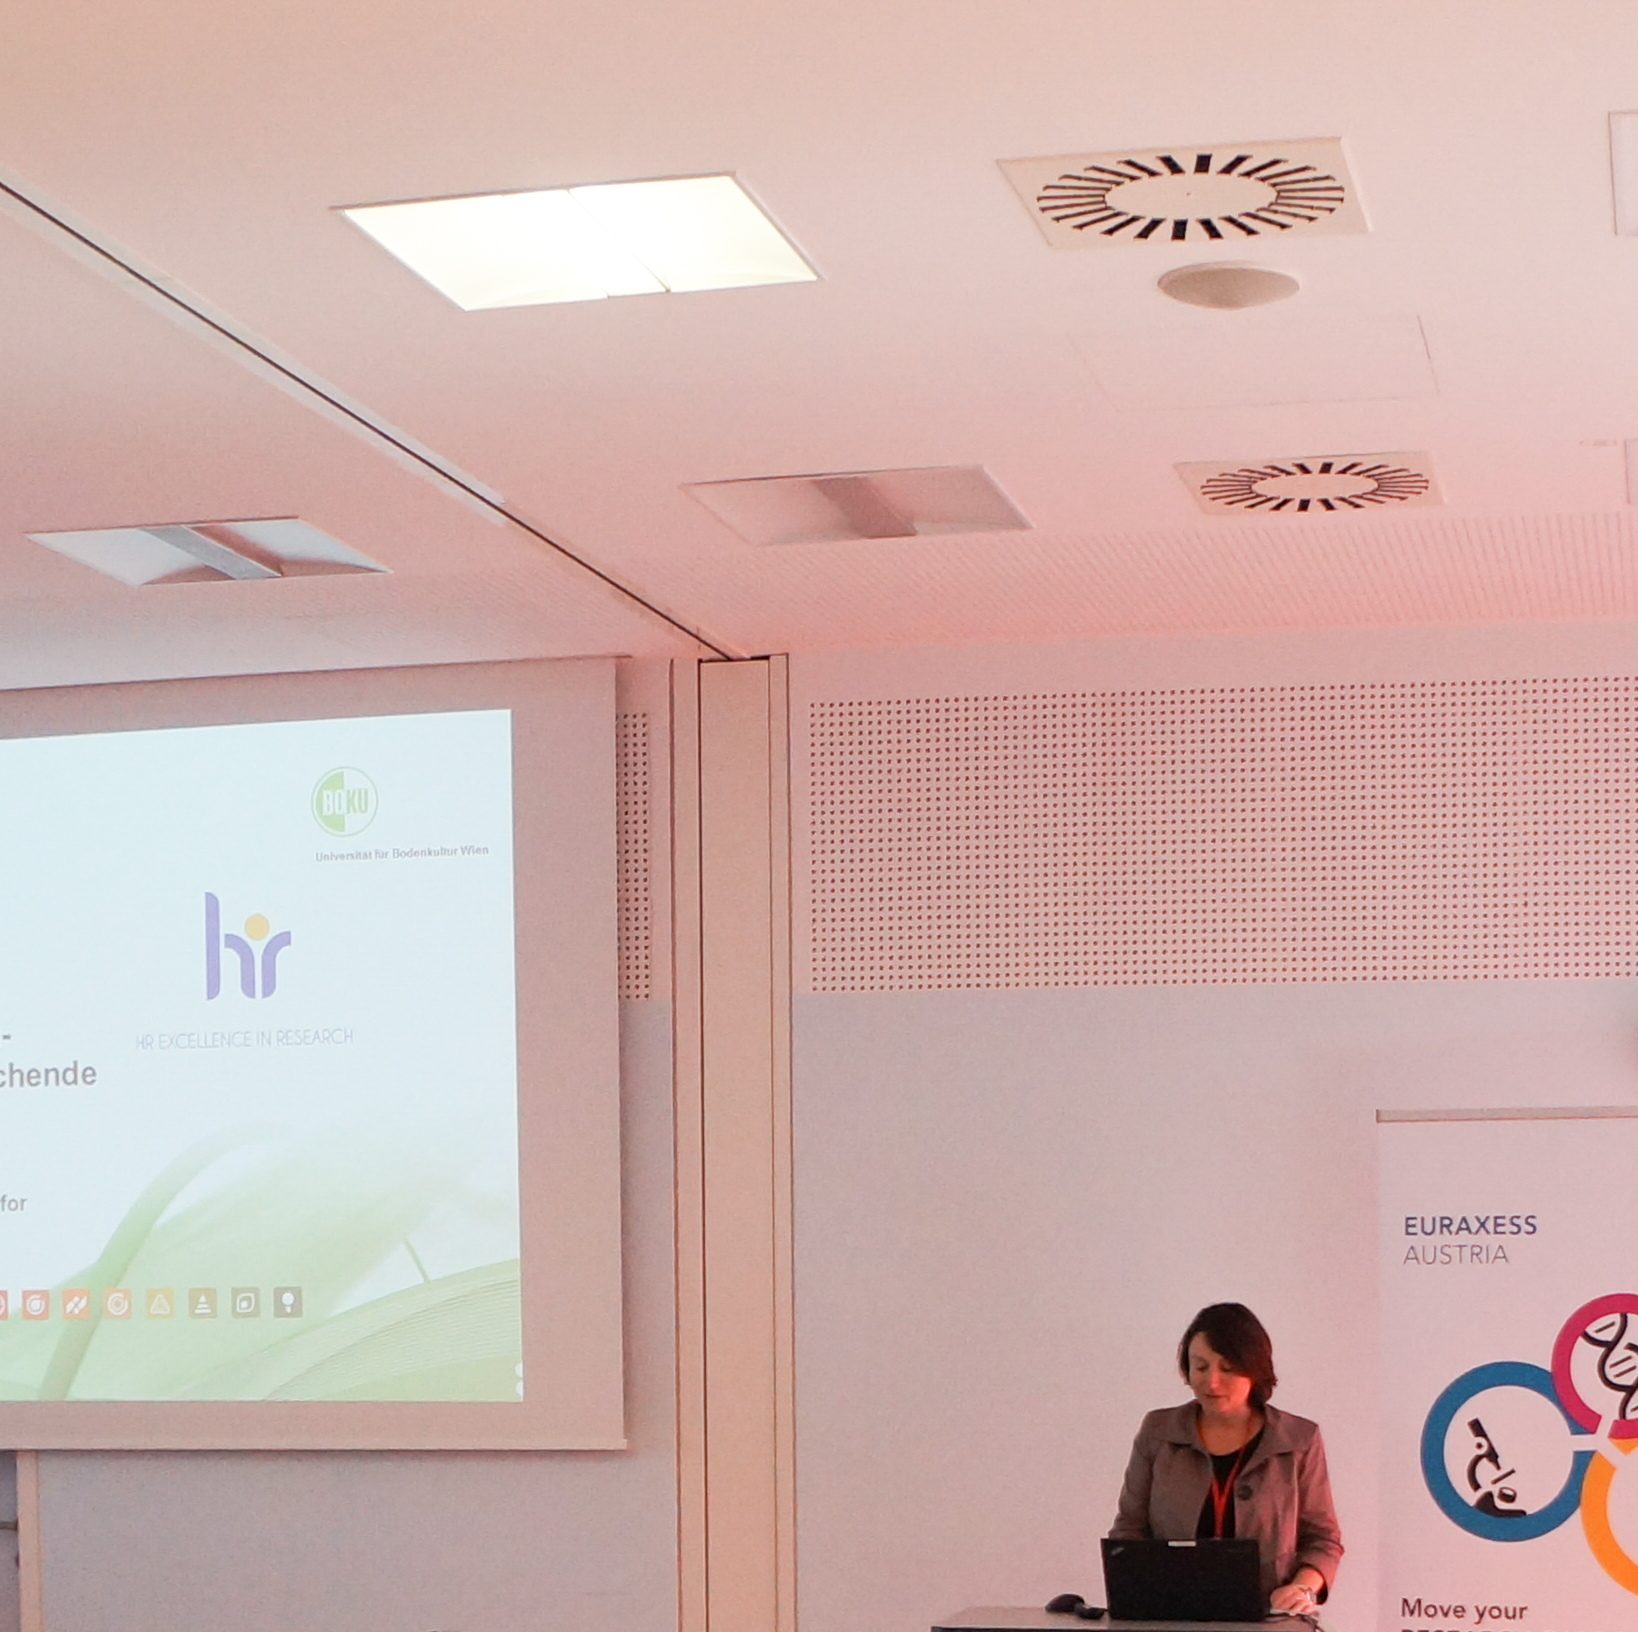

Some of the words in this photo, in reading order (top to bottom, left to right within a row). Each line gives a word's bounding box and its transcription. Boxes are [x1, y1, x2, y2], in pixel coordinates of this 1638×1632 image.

[321, 787, 369, 816] BOKU
[460, 845, 490, 856] Wien
[136, 1034, 154, 1050] HR
[158, 1031, 252, 1050] EXCELLENCE
[256, 1030, 272, 1048] IN
[275, 1028, 354, 1048] RESEARCH
[0, 1194, 27, 1213] for
[1404, 1214, 1537, 1236] EURAXESS
[1403, 1244, 1510, 1265] AUSTRIA
[1401, 1598, 1466, 1619] Move
[1474, 1604, 1528, 1625] your
